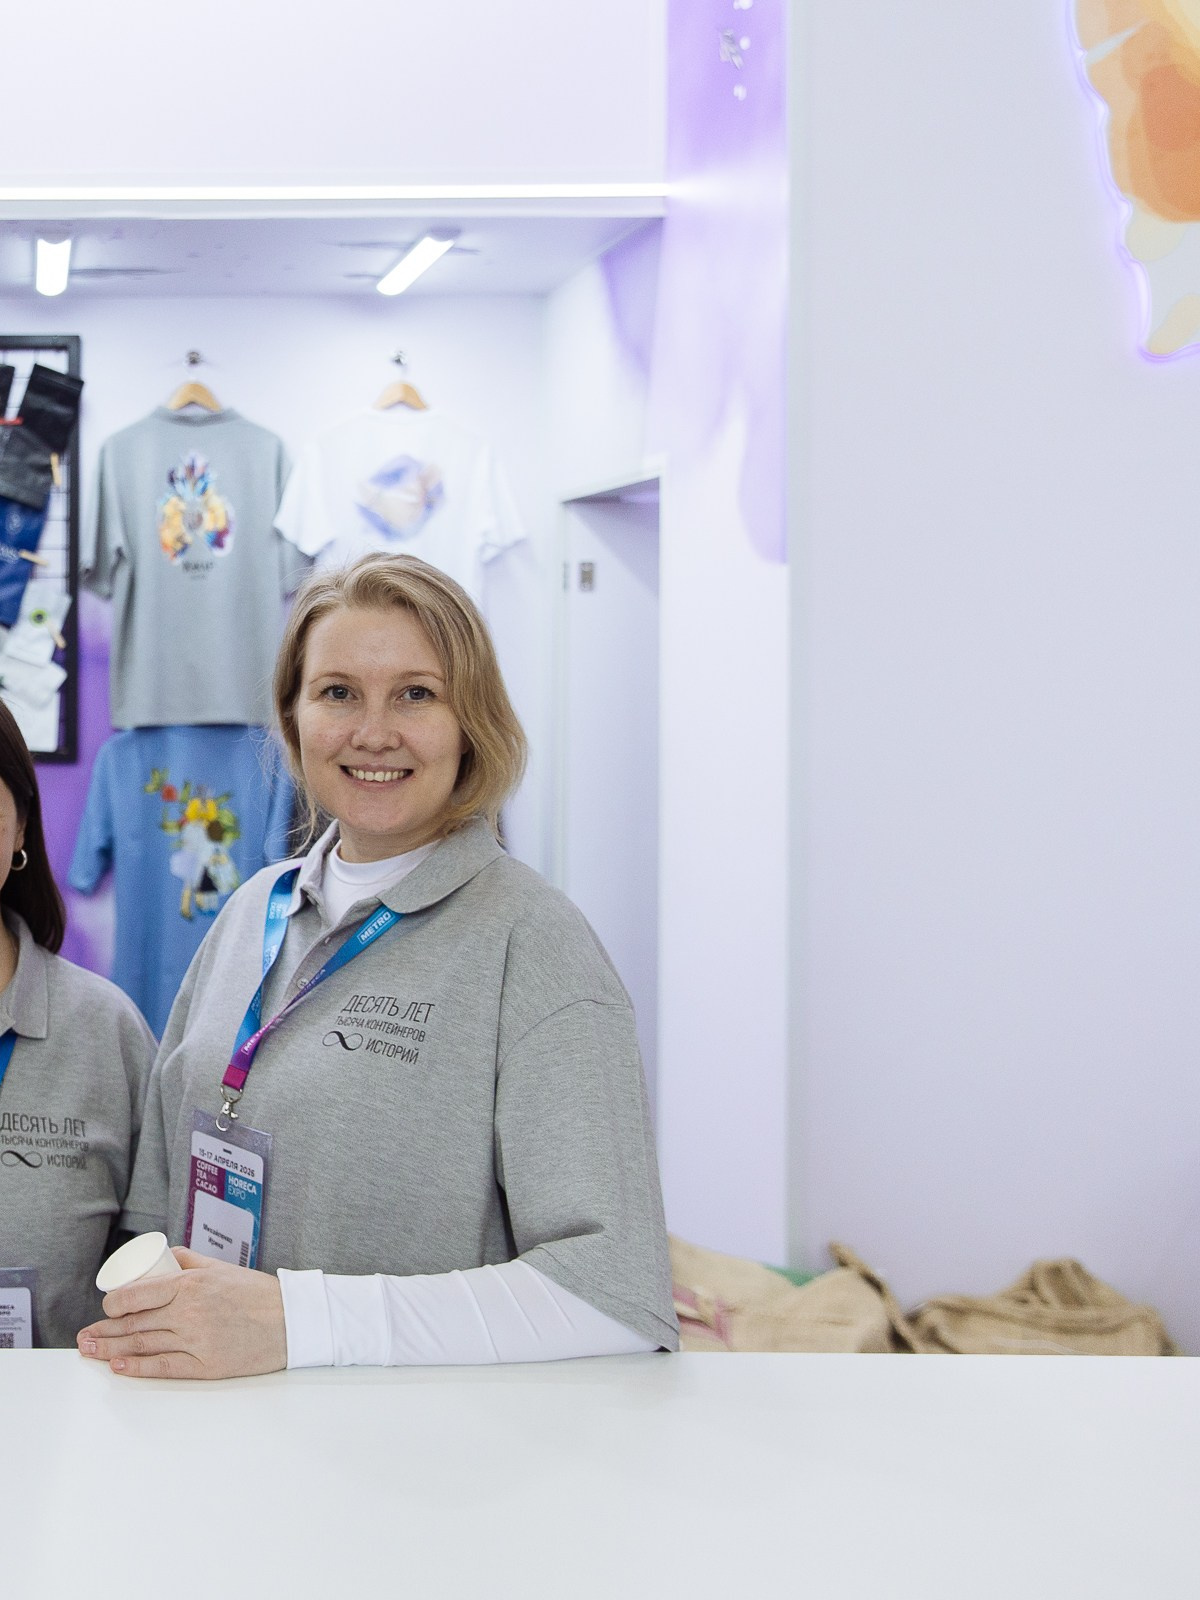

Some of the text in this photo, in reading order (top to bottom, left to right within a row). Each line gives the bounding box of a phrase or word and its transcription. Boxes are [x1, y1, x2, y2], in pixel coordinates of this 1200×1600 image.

[360, 911, 392, 941] METRO
[341, 994, 435, 1024] ДЕСЯТЬ ЛЕТ
[363, 1019, 426, 1043] КОНТЕЙНЕРОВ
[365, 1038, 419, 1065] ИСТОРИЙ
[0, 1111, 87, 1138] ДЕСЯТЬ ЛЕТ
[196, 1159, 218, 1177] COFFEE
[213, 1153, 239, 1171] АПРЕЛЯ
[196, 1168, 207, 1180] TEA
[195, 1178, 218, 1194] CACAO
[227, 1175, 257, 1195] HORECA
[227, 1187, 246, 1200] EXPO
